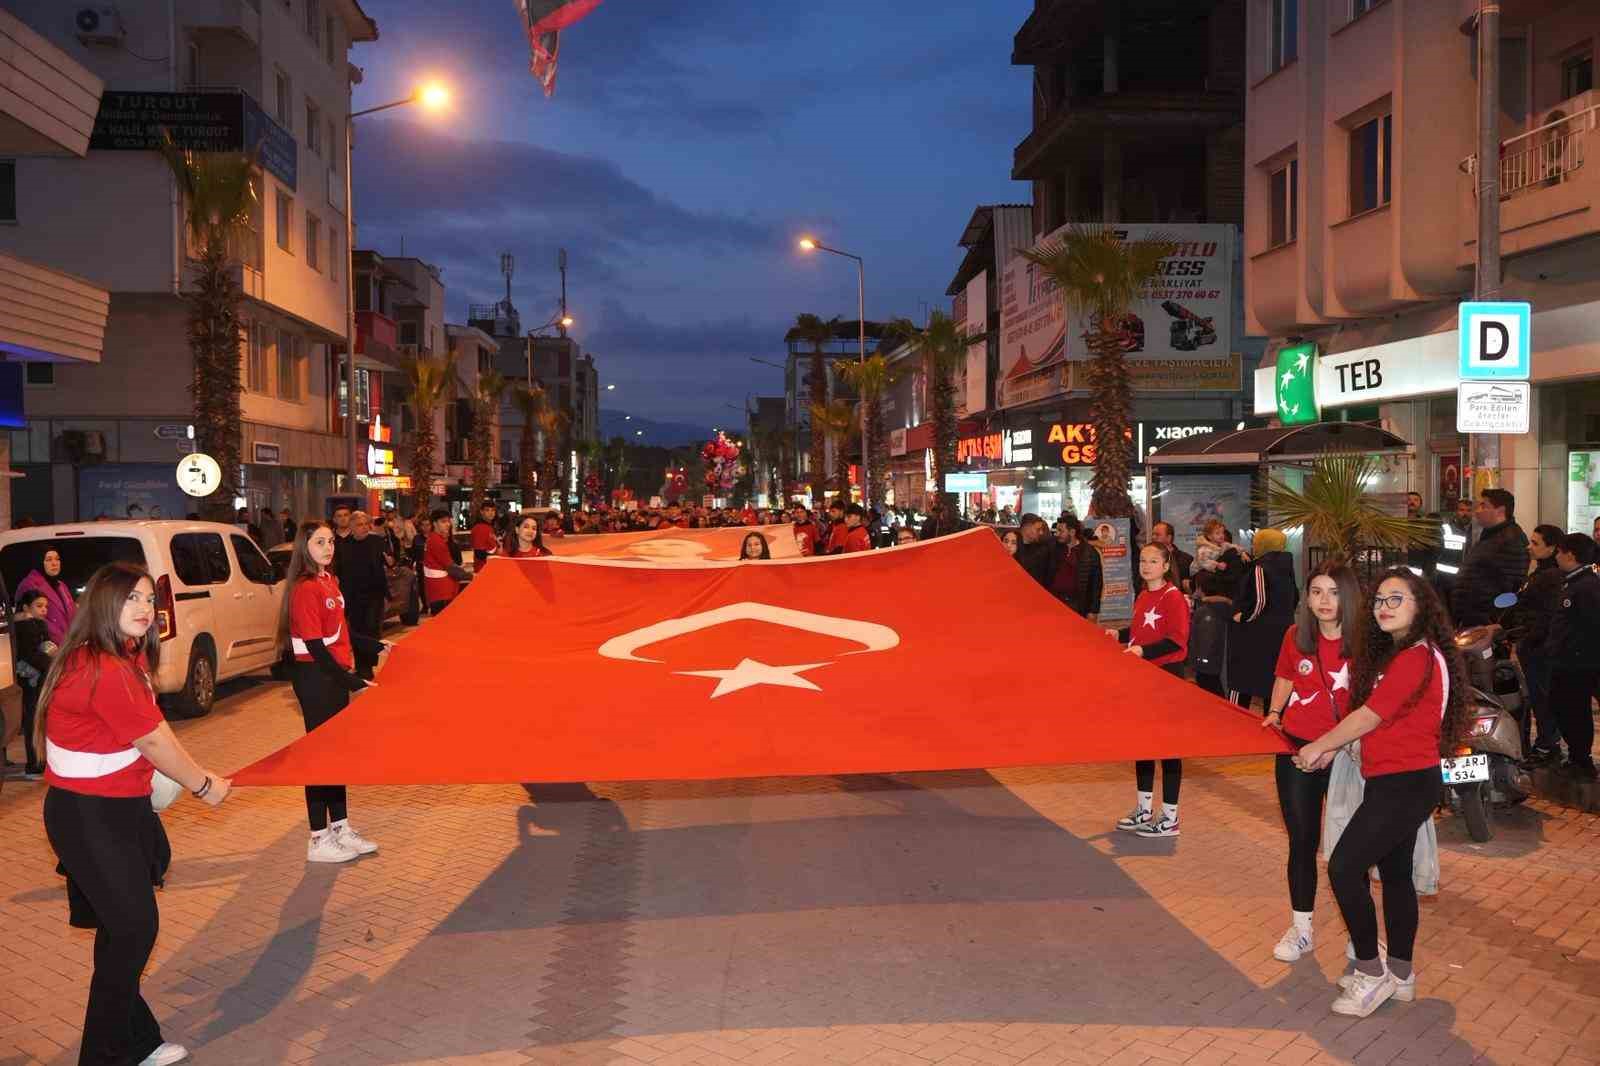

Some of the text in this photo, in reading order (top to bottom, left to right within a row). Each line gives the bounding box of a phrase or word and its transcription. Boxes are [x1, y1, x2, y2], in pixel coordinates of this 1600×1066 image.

[1479, 320, 1510, 361] D
[1335, 359, 1383, 393] TEB
[1062, 445, 1097, 464] GS
[1455, 770, 1475, 780] 534
